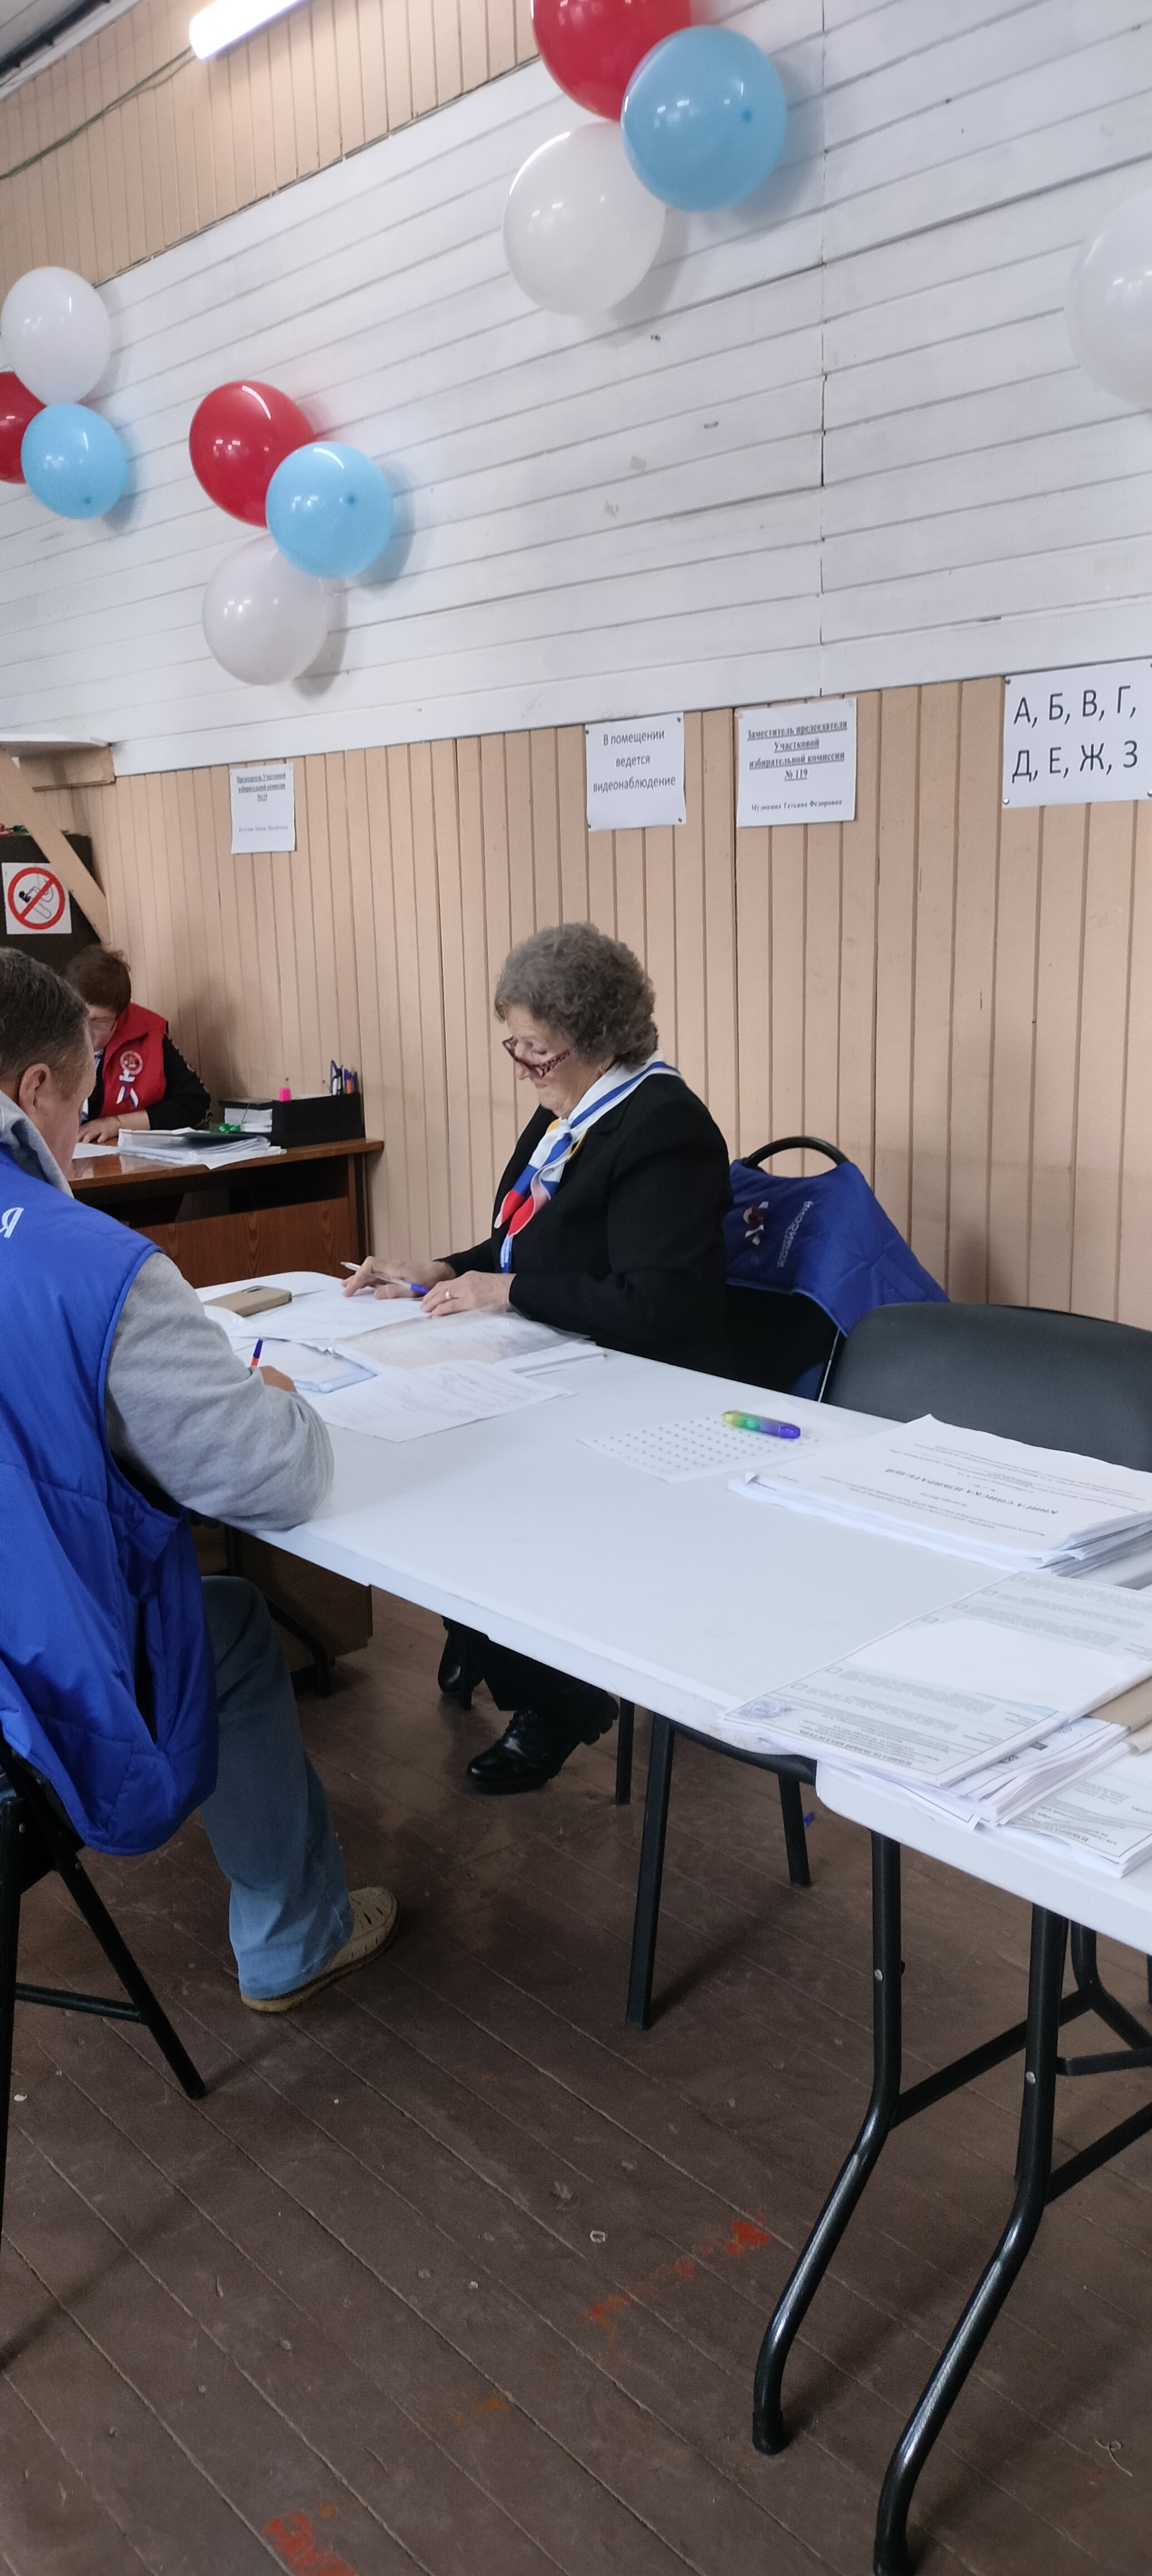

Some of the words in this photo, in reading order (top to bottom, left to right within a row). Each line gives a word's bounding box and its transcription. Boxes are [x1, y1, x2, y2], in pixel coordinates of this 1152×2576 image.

[1013, 697, 1038, 728] А,
[1049, 692, 1071, 725] Б,
[1082, 689, 1105, 721] В,
[1117, 685, 1136, 718] Г,
[796, 721, 847, 734] председателя
[603, 734, 608, 746] В
[611, 730, 665, 745] помещении
[774, 737, 819, 751] Участковой
[616, 755, 650, 769] ведется
[749, 754, 805, 768] избирательной
[807, 752, 845, 764] комиссии
[1012, 750, 1038, 784] Д,
[1050, 747, 1069, 779] Е,
[1080, 743, 1112, 775] Ж,
[1123, 740, 1138, 768] З
[795, 768, 808, 779] 119
[593, 776, 676, 794] видеонаблюдение
